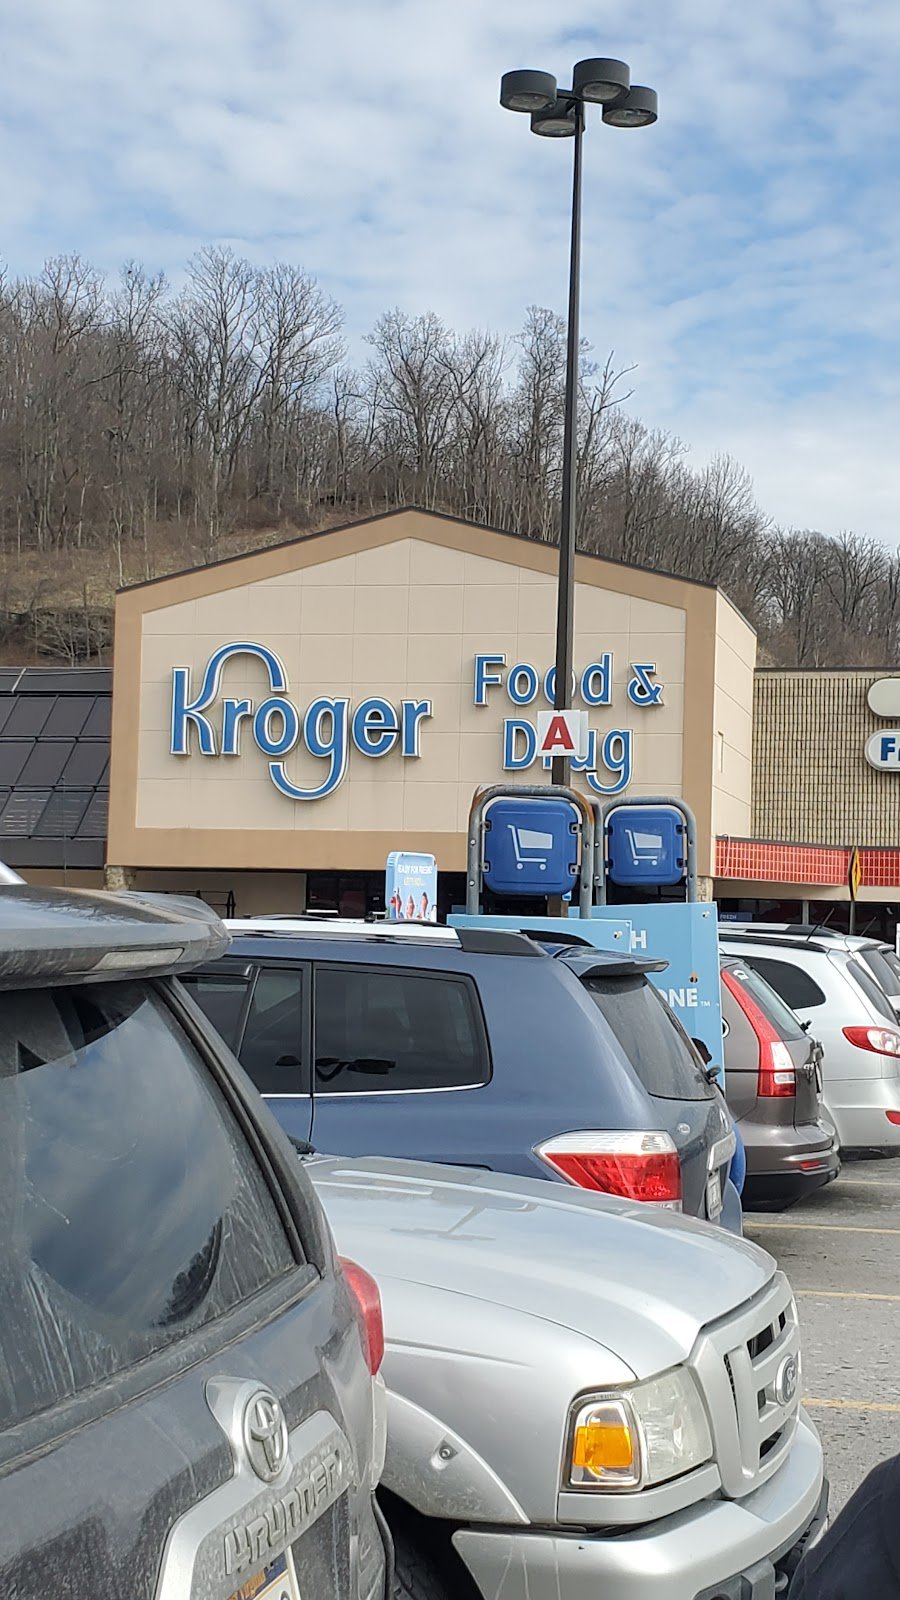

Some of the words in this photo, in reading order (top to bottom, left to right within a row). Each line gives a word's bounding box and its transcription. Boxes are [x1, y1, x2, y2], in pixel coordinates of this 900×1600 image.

[627, 662, 665, 707] &
[169, 640, 434, 801] Kroger
[541, 715, 576, 751] A
[502, 718, 634, 795] Dug
[880, 736, 900, 762] F
